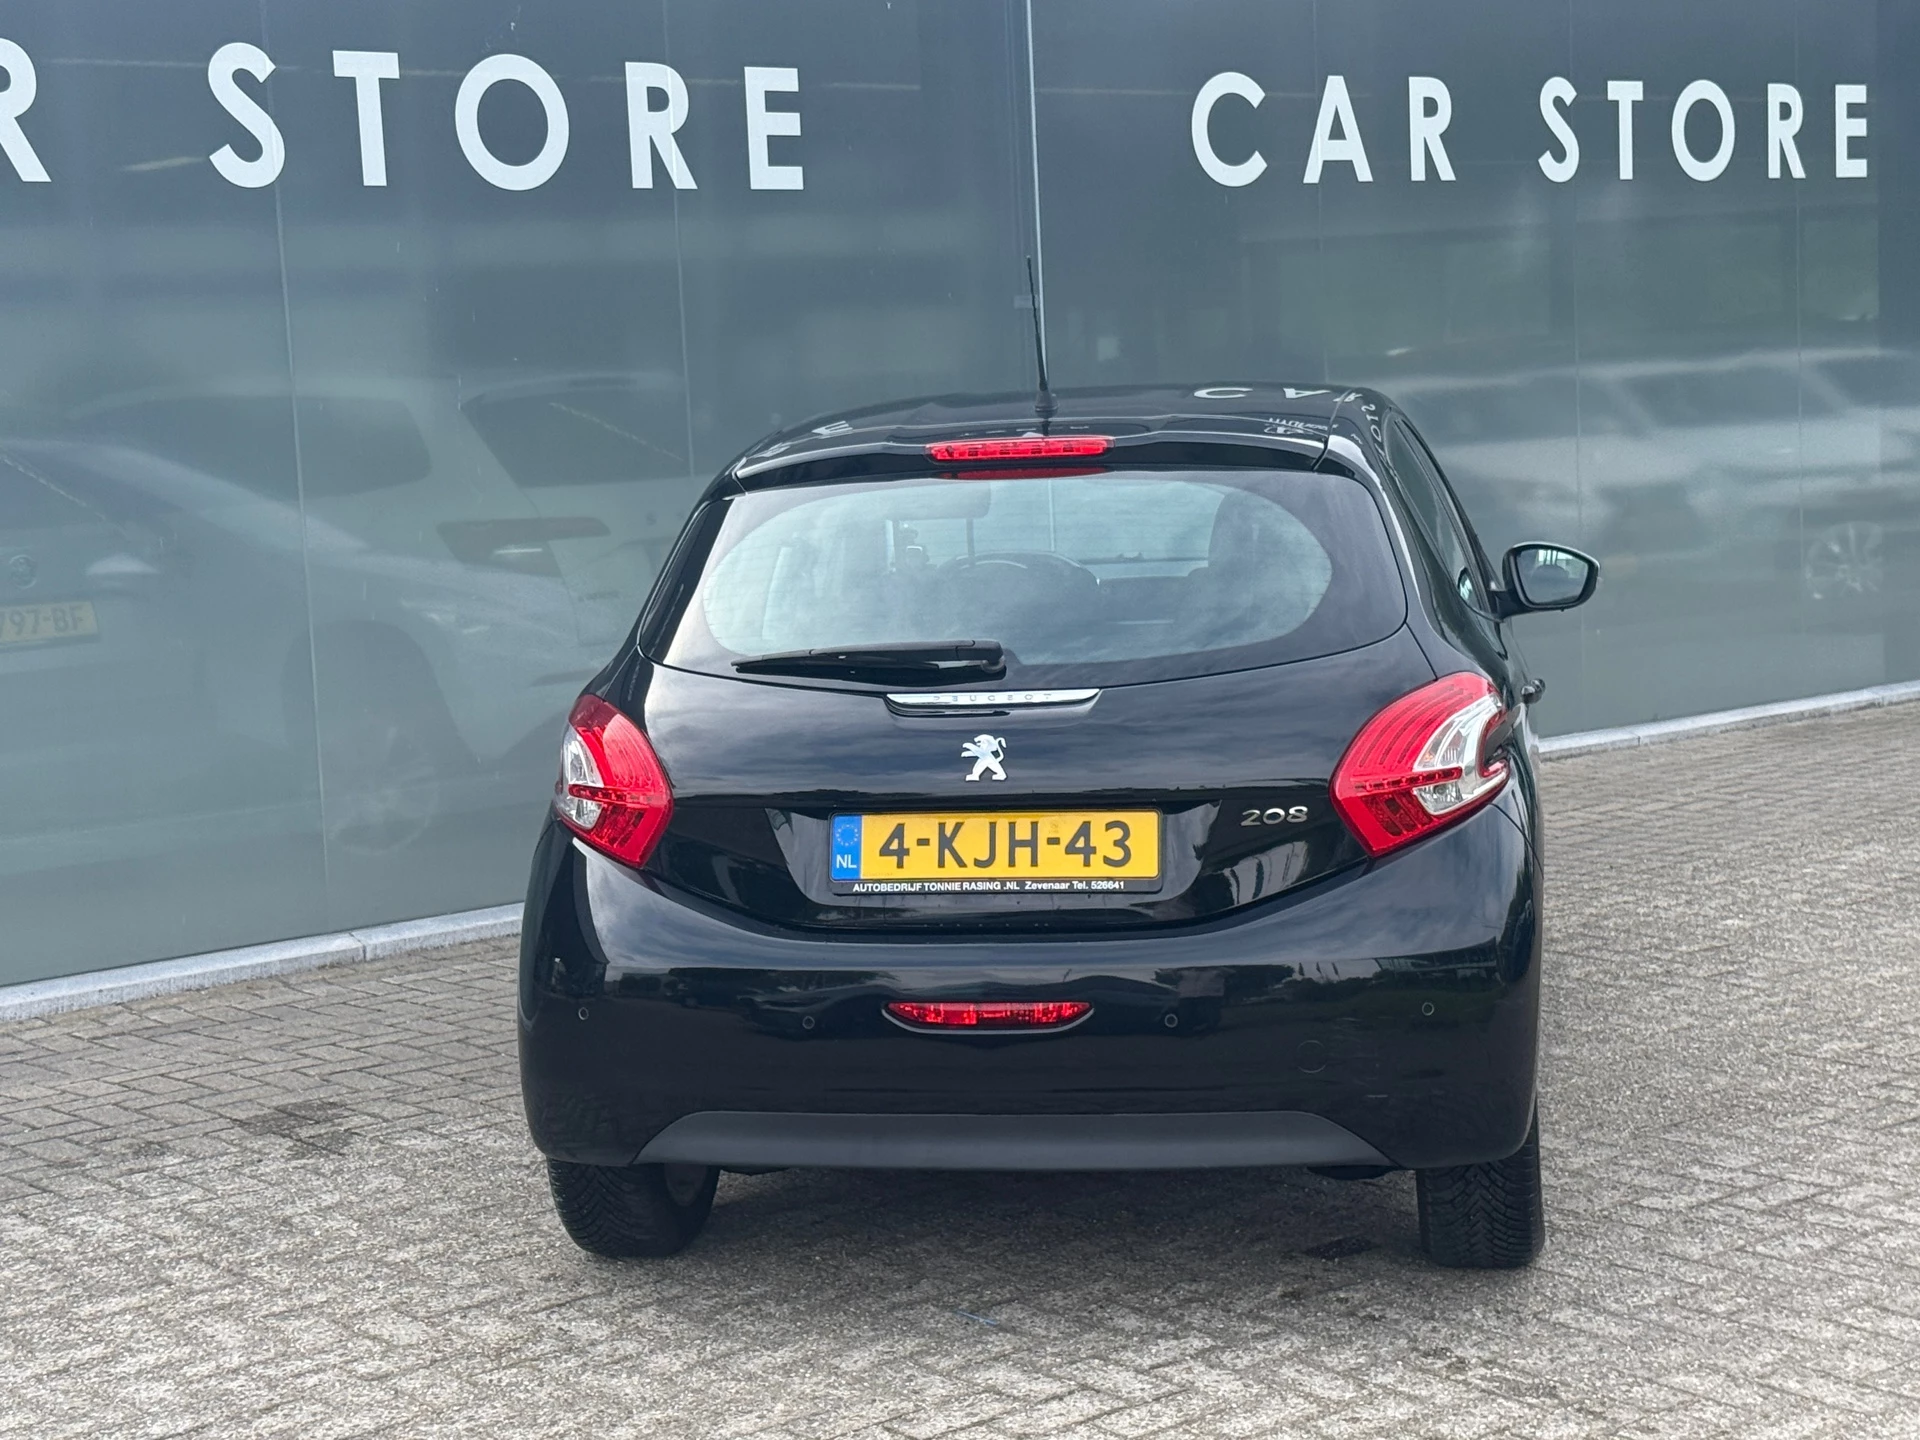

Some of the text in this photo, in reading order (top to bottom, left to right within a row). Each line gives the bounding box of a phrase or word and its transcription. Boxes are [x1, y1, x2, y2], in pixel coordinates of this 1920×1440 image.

[207, 42, 804, 191] STORE
[1191, 71, 1868, 187] CAR STORE
[1240, 805, 1308, 826] 208
[836, 854, 857, 869] NL
[879, 820, 1132, 869] 4-KJH-43
[852, 882, 922, 892] AUTOBEDRIJF
[923, 882, 962, 892] TONNIE
[963, 881, 1001, 891] RASING
[1025, 880, 1071, 890] Zevenaar
[1072, 880, 1089, 890] Tel.
[1091, 880, 1124, 890] 526641
